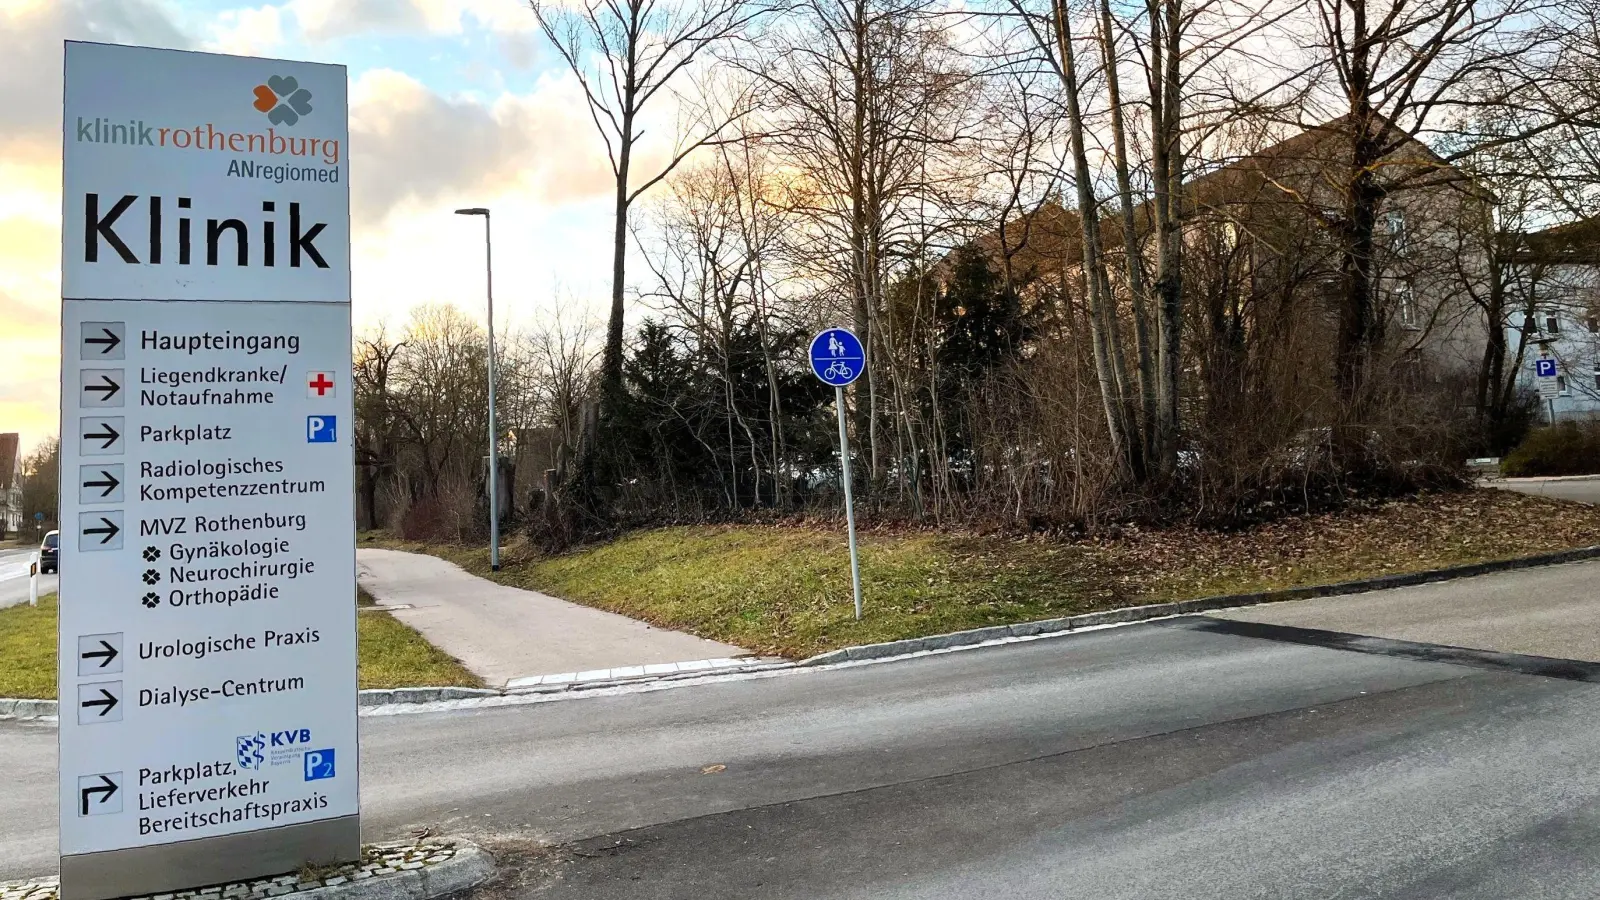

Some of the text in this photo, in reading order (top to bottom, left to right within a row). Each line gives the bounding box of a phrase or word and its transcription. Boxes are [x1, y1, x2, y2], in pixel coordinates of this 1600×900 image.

[227, 159, 339, 183] ANregiomed
[85, 193, 330, 268] Klinik
[141, 330, 300, 355] Haupteingang
[140, 365, 287, 387] Liegendkranke/
[1540, 361, 1551, 375] P
[140, 389, 274, 406] Notaufnahme
[140, 424, 232, 445] Parkplatz
[140, 457, 284, 479] Radiologisches
[140, 479, 325, 503] Kompetenzzentrum
[140, 513, 306, 536] MVZ Rothenburg
[170, 537, 290, 563] Gynäkologie
[170, 558, 315, 583] Neurochirurgie
[169, 583, 279, 606] Orthopädie
[139, 627, 320, 659] Urologische Praxis
[139, 676, 304, 706] Dialyse-Centrum
[270, 729, 311, 746] KVB
[139, 760, 237, 786] Parkplatz,
[139, 779, 269, 811] Lieferverkehr
[139, 792, 328, 835] Bereitschaftspraxis
